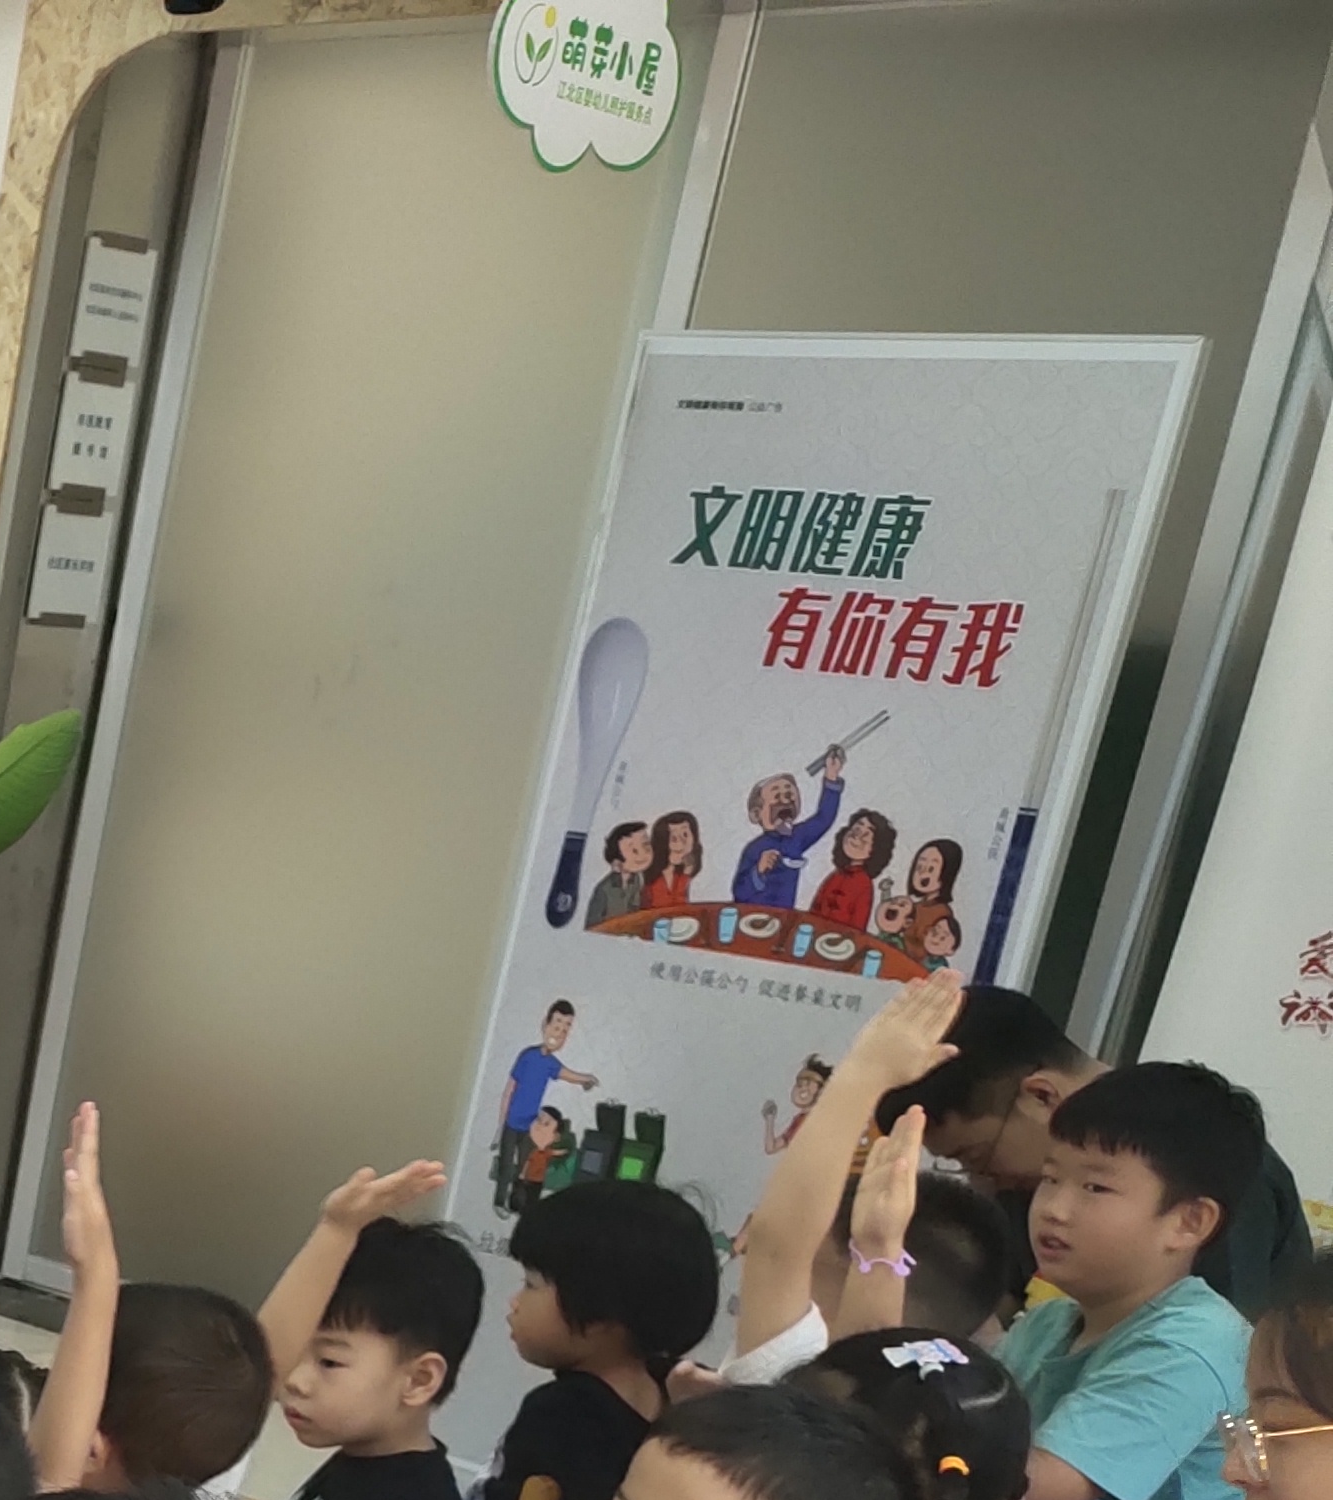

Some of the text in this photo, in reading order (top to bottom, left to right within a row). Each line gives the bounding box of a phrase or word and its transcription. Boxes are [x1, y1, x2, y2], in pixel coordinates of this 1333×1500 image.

[561, 16, 662, 96] 萌芽小屋
[669, 484, 933, 580] 文明健康
[761, 587, 1025, 688] 有你有我
